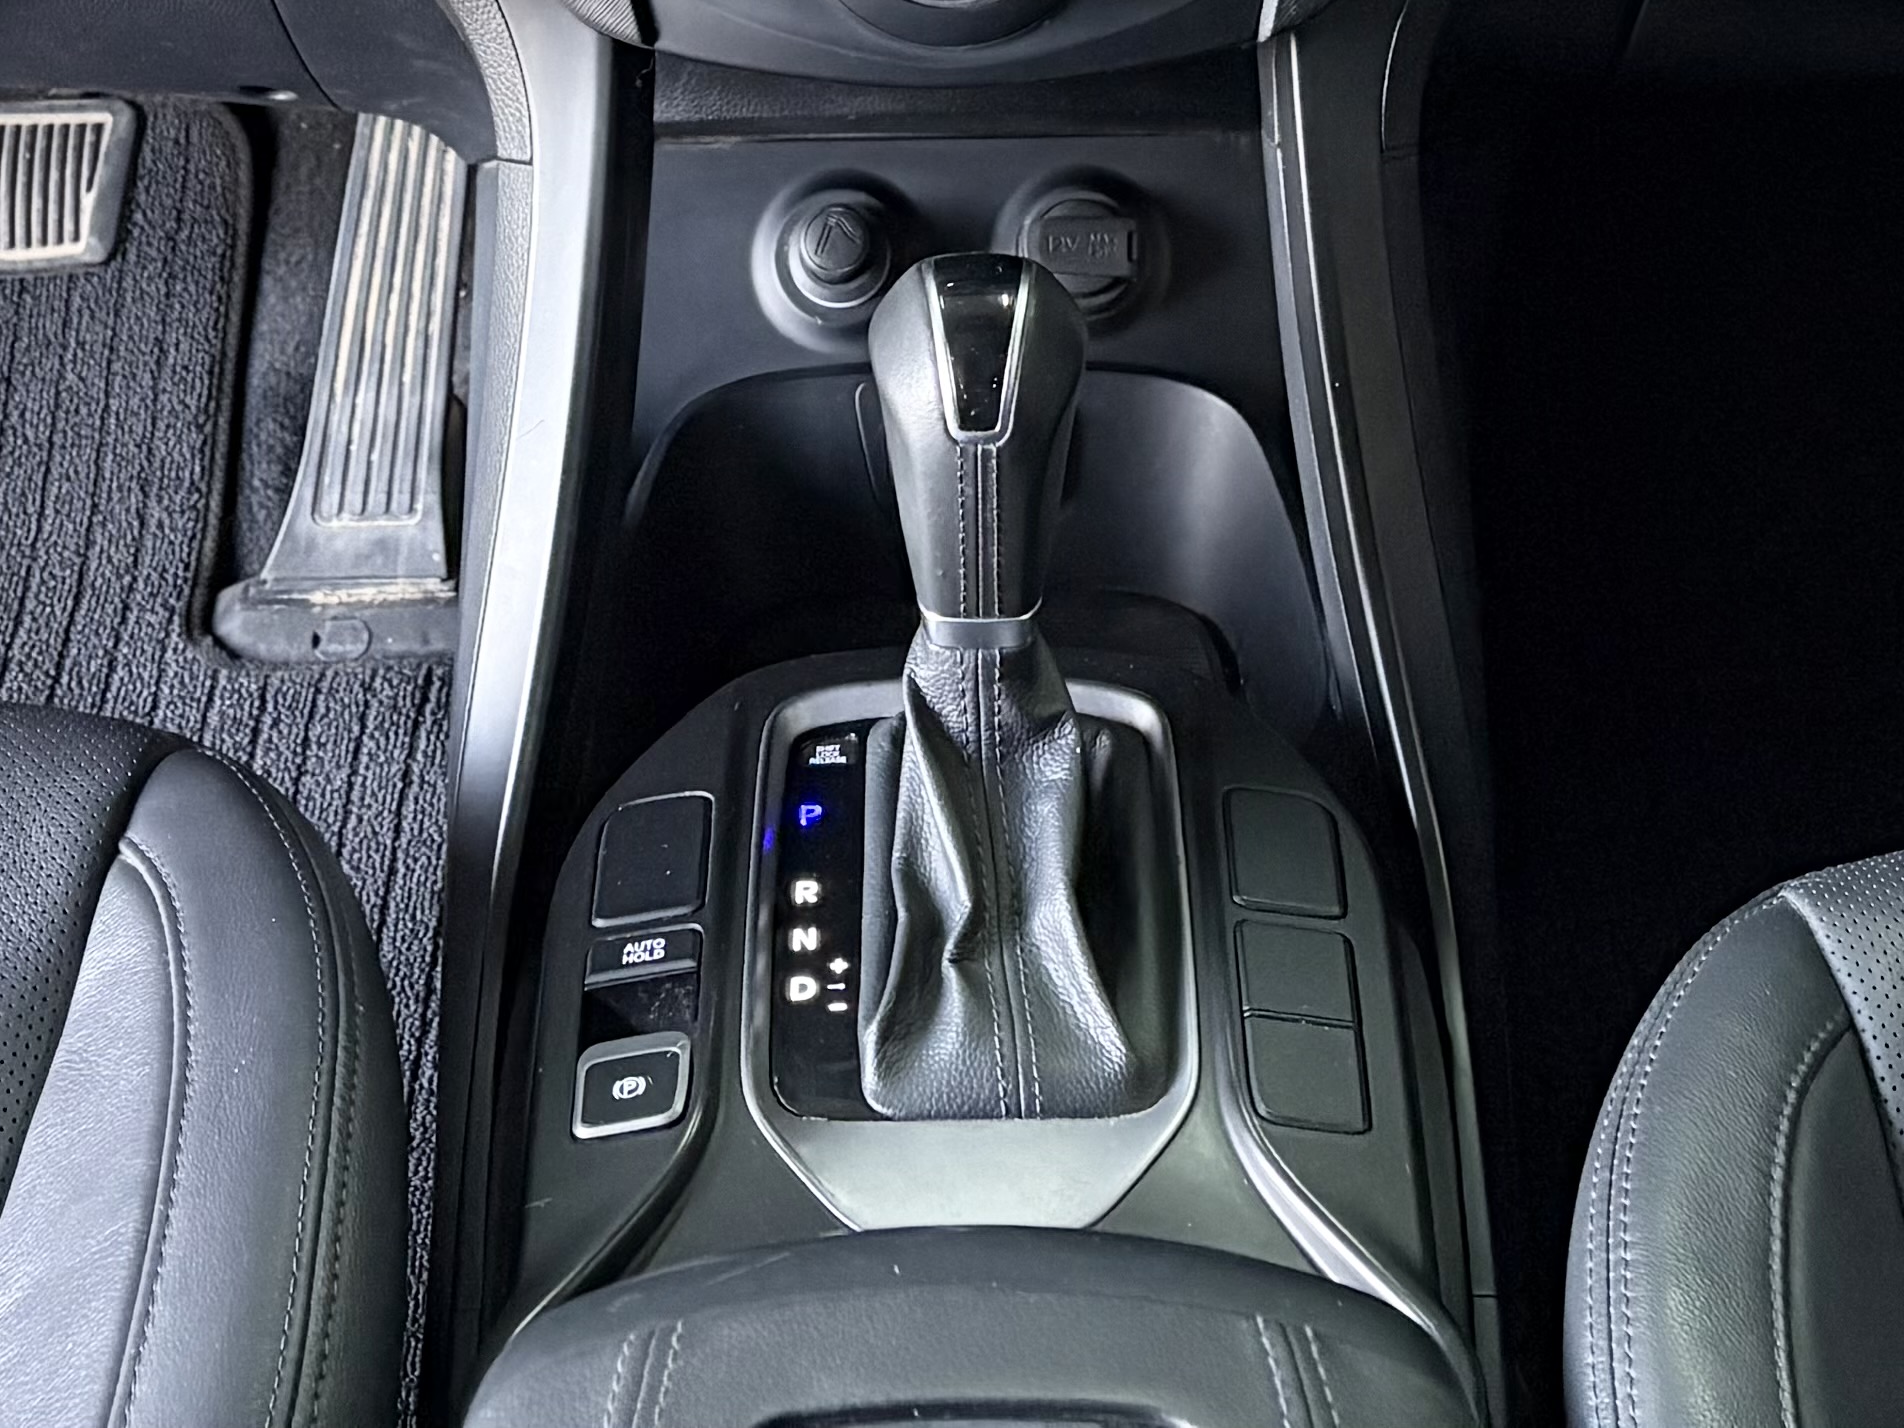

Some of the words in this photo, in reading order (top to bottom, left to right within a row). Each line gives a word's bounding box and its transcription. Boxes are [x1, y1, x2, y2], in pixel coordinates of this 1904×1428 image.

[799, 803, 823, 827] P
[794, 880, 819, 906] R
[623, 937, 666, 954] AUTO
[791, 926, 818, 952] N
[622, 948, 665, 965] HOLD
[789, 975, 817, 1002] D
